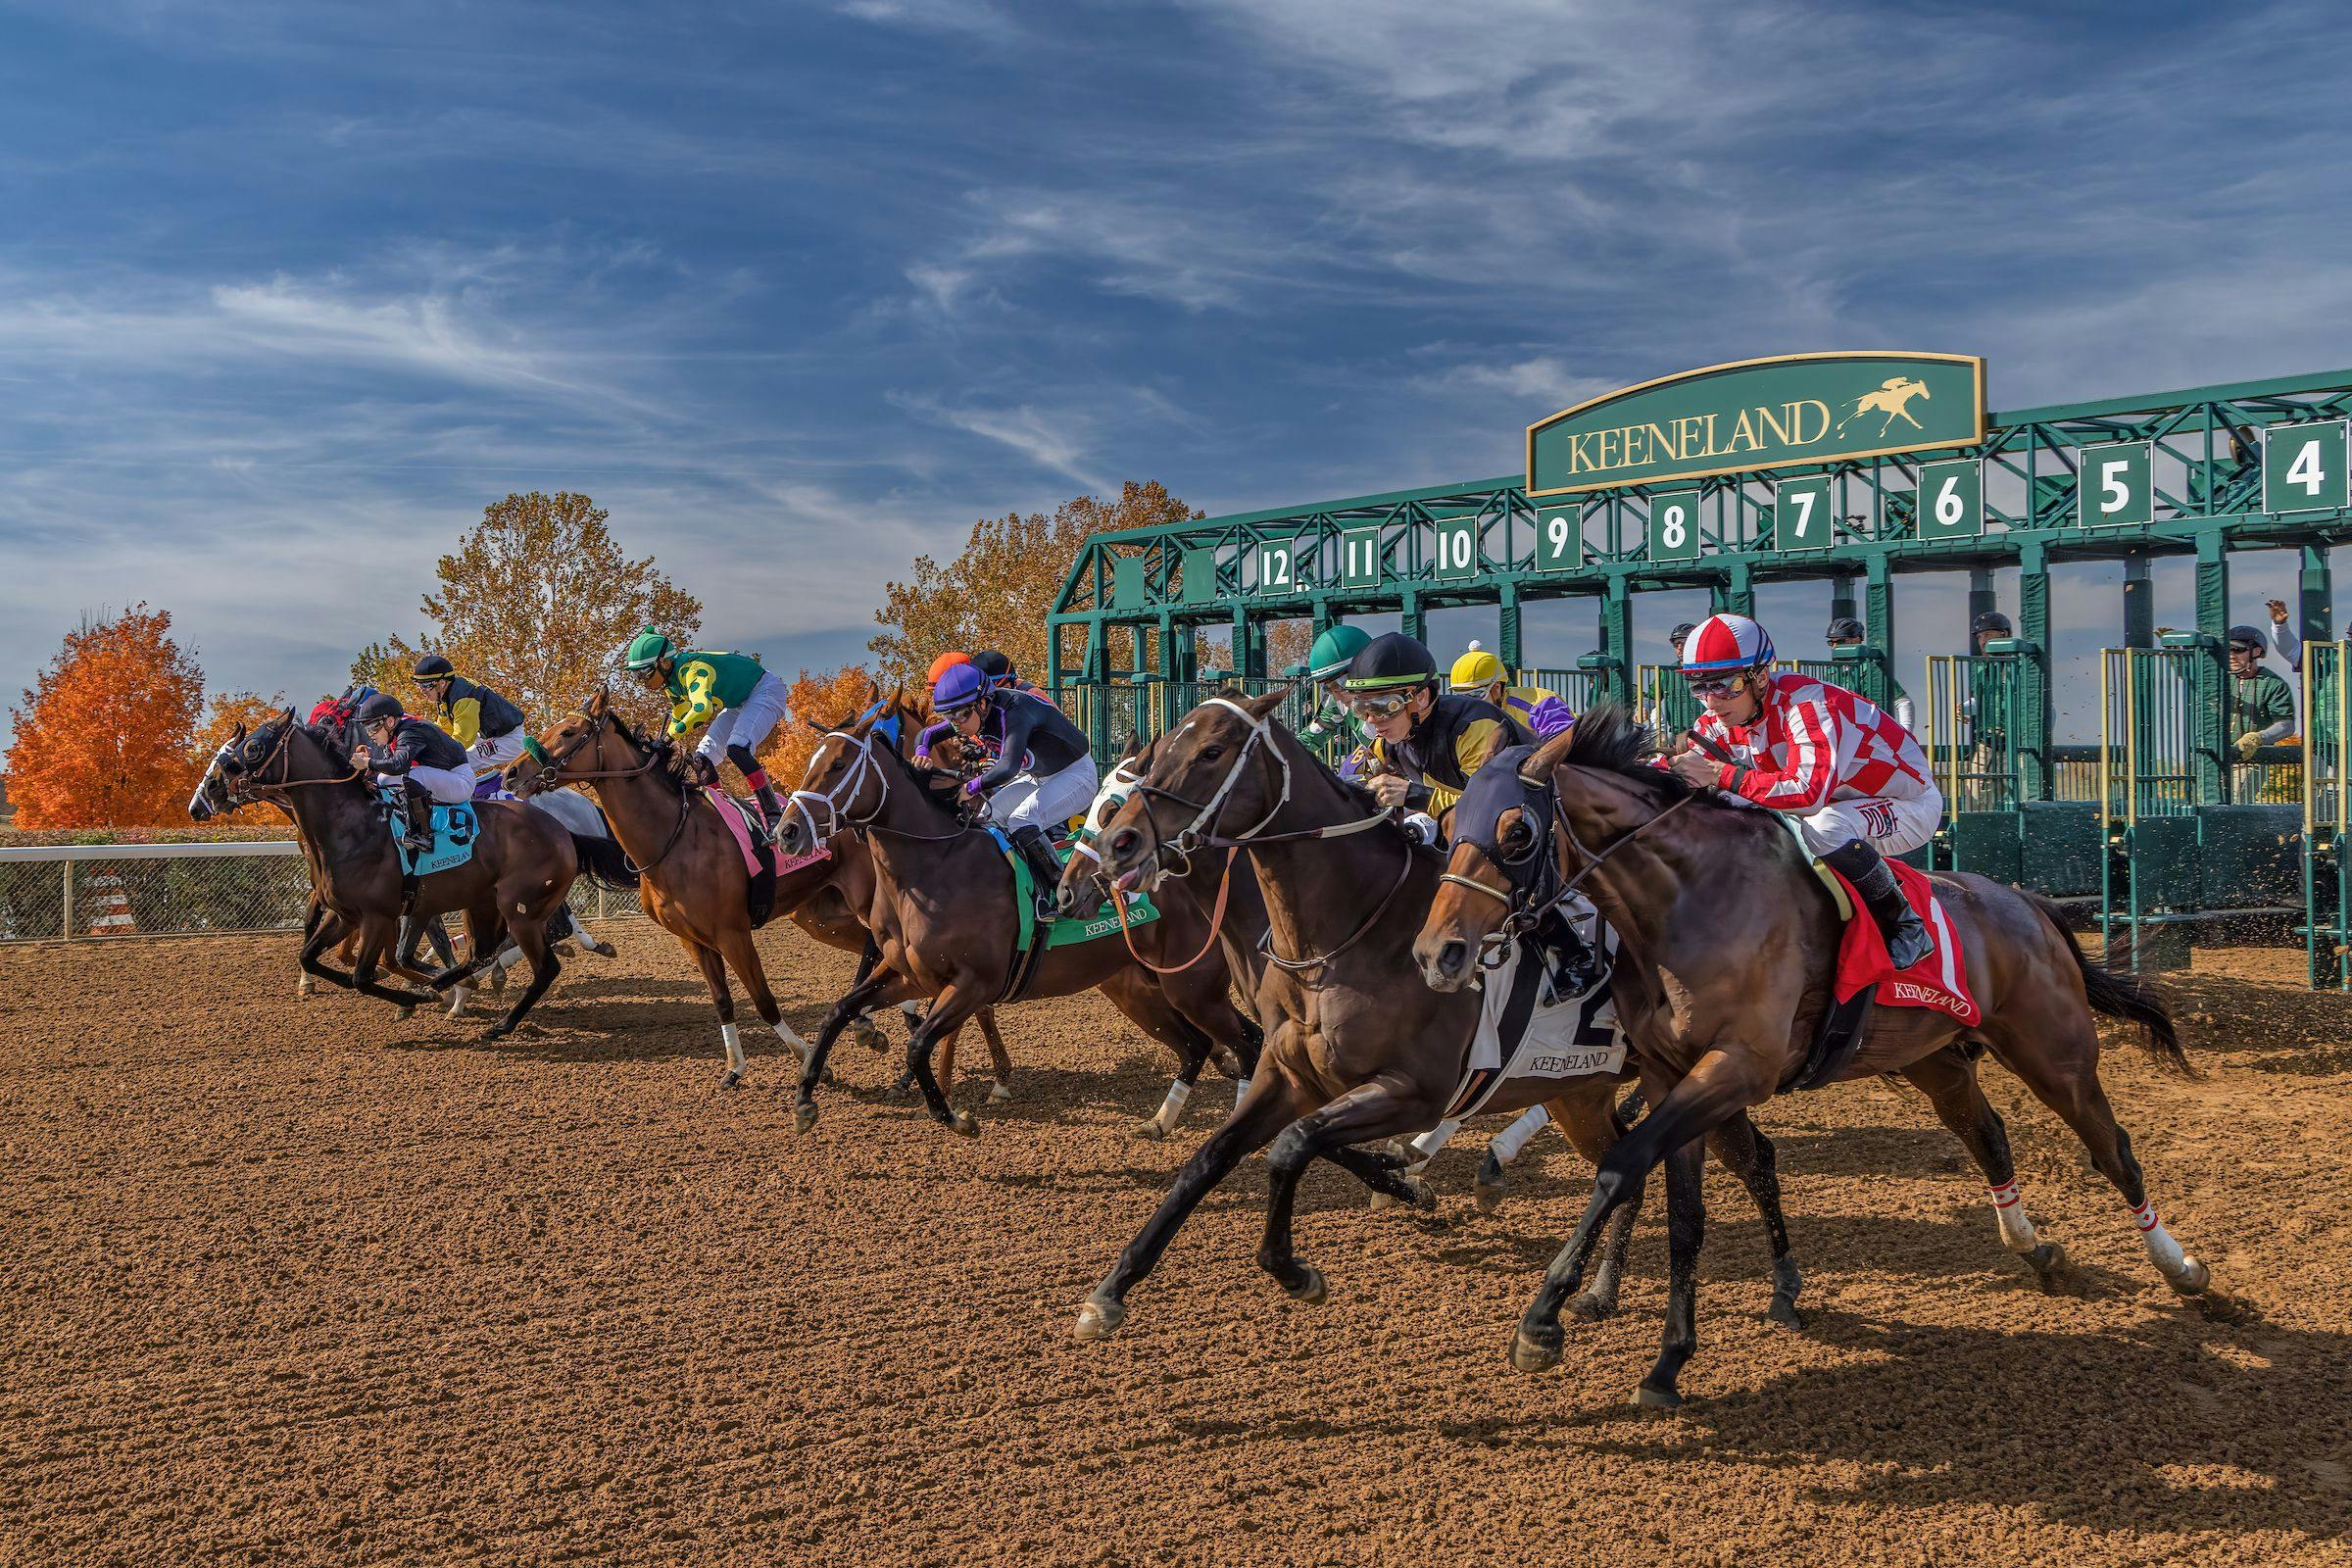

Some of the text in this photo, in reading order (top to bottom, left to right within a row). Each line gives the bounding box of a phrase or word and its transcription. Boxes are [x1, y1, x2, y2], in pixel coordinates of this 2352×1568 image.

[1567, 399, 1832, 475] KEENELAND
[2100, 460, 2131, 514] 5
[2285, 439, 2325, 496] 4
[1790, 491, 1817, 538] 7
[1935, 475, 1964, 526] 6
[1439, 528, 1471, 570] 10
[1547, 515, 1570, 560] 9
[1663, 505, 1687, 549] 8
[1263, 549, 1290, 586] 12
[1348, 538, 1373, 577] 11
[448, 807, 474, 847] 9
[1930, 896, 1968, 1002] 1
[1892, 982, 1972, 1018] KEENELAND
[1529, 1052, 1609, 1073] KEENELAND
